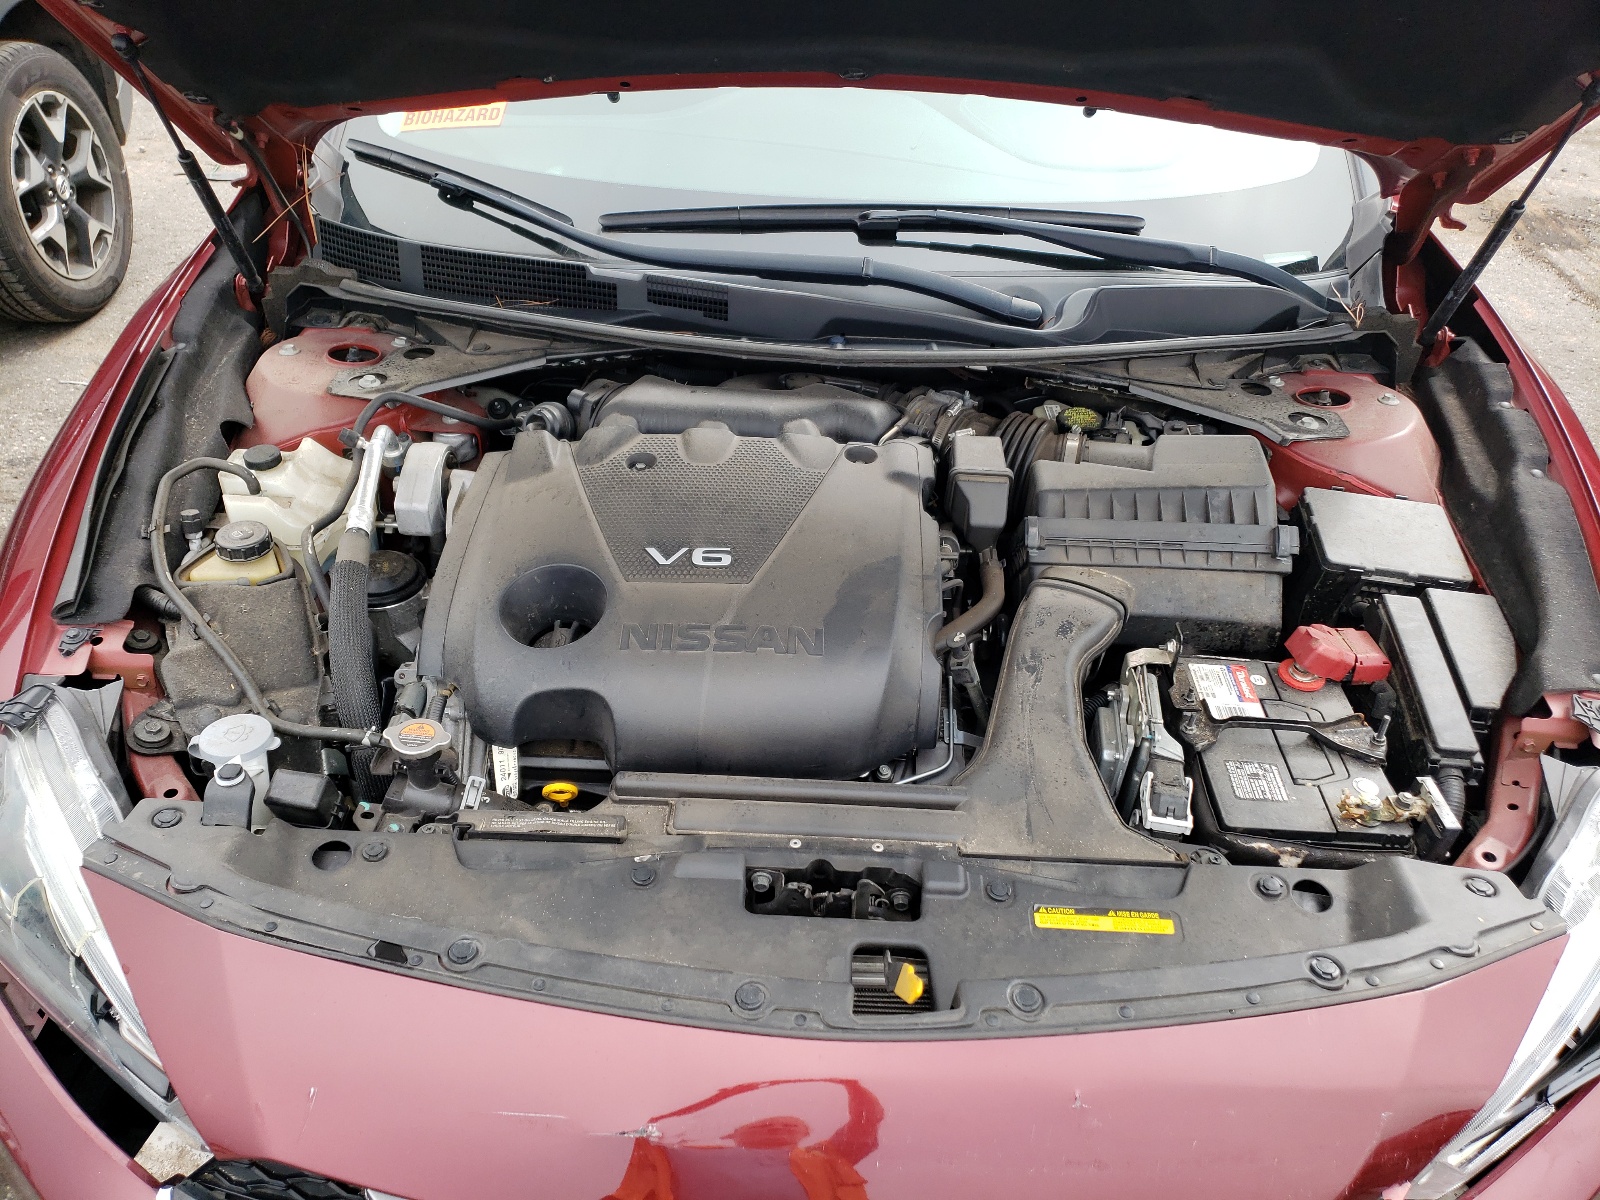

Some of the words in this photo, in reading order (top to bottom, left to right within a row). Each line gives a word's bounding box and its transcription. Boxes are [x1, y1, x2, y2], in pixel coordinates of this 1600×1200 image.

[403, 107, 501, 126] BIOHAZARD
[645, 547, 732, 567] V6
[619, 622, 825, 657] NISSAN
[1047, 907, 1075, 915] CAUTION
